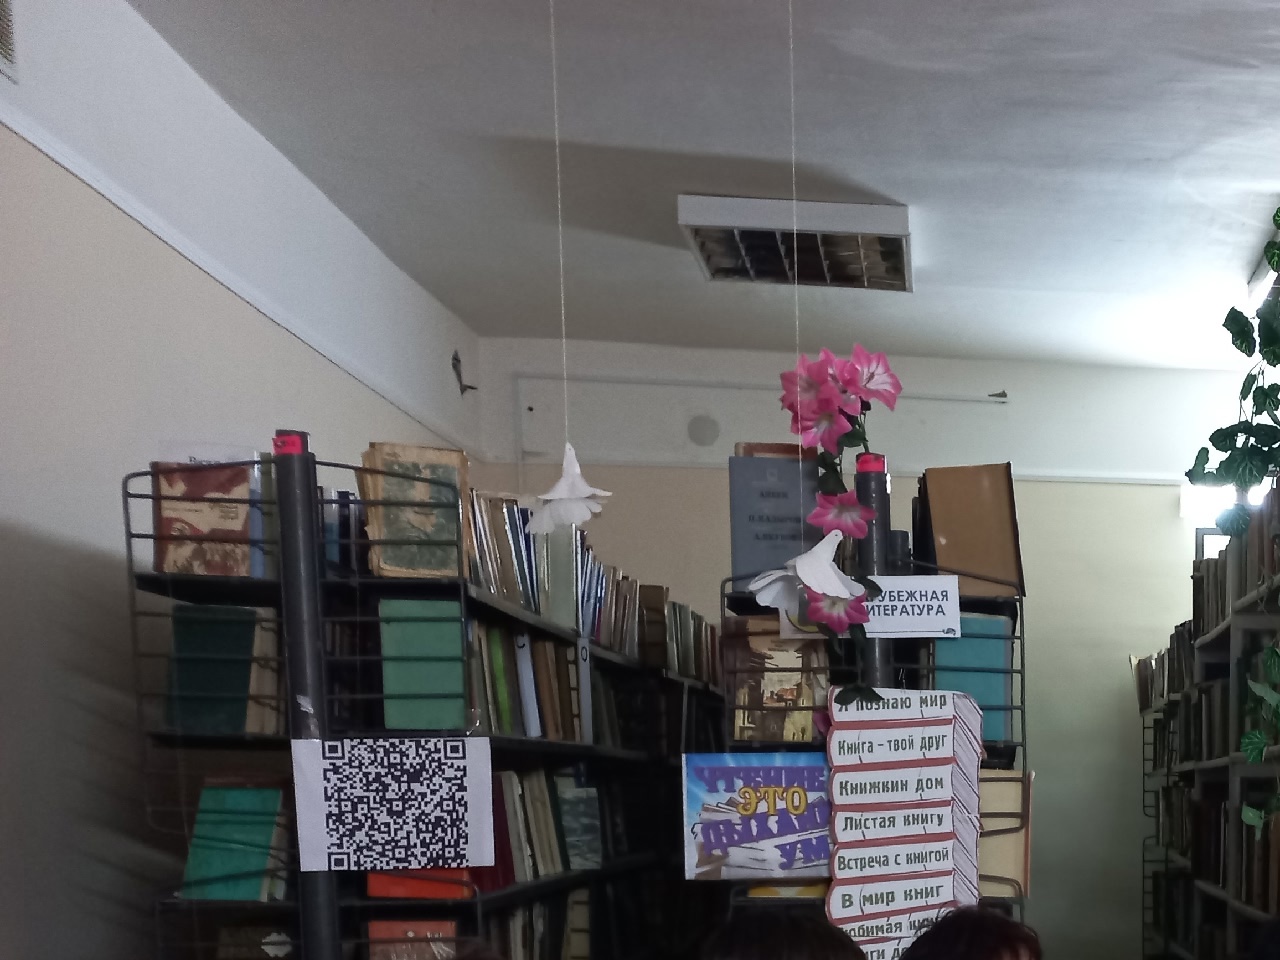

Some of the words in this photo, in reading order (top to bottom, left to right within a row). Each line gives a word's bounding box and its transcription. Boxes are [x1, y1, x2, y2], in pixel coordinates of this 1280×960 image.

[869, 590, 949, 602] УБЕЖНАЯ
[866, 604, 946, 616] ИТЕРАТУРА
[920, 694, 947, 709] мир
[838, 739, 874, 756] Книга
[887, 735, 914, 752] твой
[919, 734, 948, 752] друг
[839, 778, 909, 797] Книжкин
[915, 776, 945, 794] дом
[736, 785, 808, 817] ЭТО
[842, 815, 896, 832] Листая
[903, 812, 944, 827] книгу
[774, 835, 830, 870] УМ
[837, 851, 890, 872] Встреча
[894, 853, 901, 865] с
[905, 847, 949, 865] книгой
[841, 893, 854, 909] В
[861, 890, 895, 907] мир
[904, 885, 945, 901] книг
[842, 920, 903, 937] юбимая
